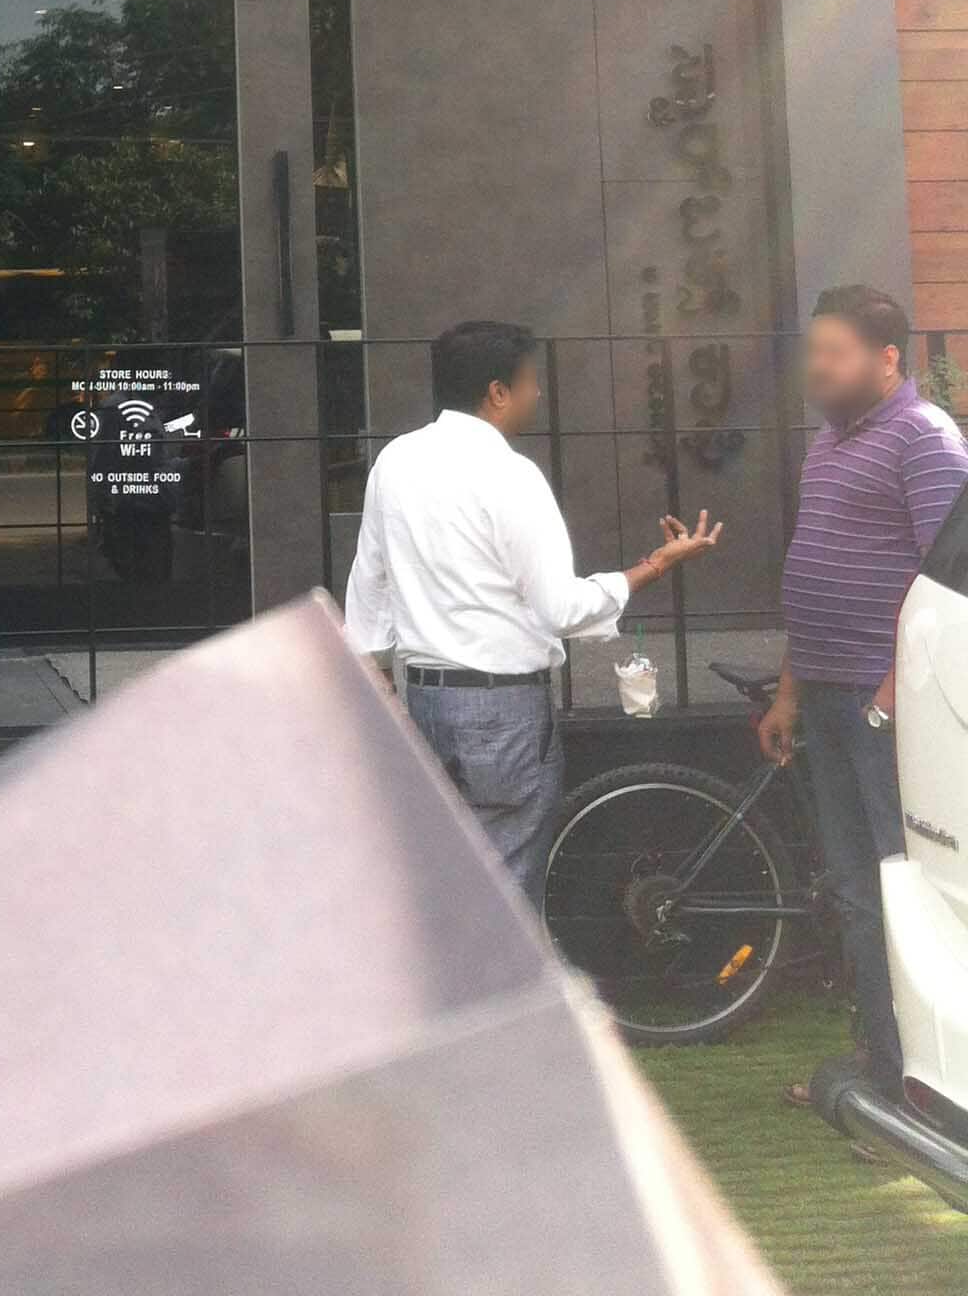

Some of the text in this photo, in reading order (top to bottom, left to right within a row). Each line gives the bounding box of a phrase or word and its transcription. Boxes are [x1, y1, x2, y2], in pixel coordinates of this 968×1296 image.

[99, 369, 132, 380] STORE
[119, 430, 153, 441] Free
[119, 443, 152, 457] Wi-Fi
[107, 472, 150, 483] OUTSIDE
[153, 472, 182, 483] FOOD
[111, 484, 160, 495] & DRINKS
